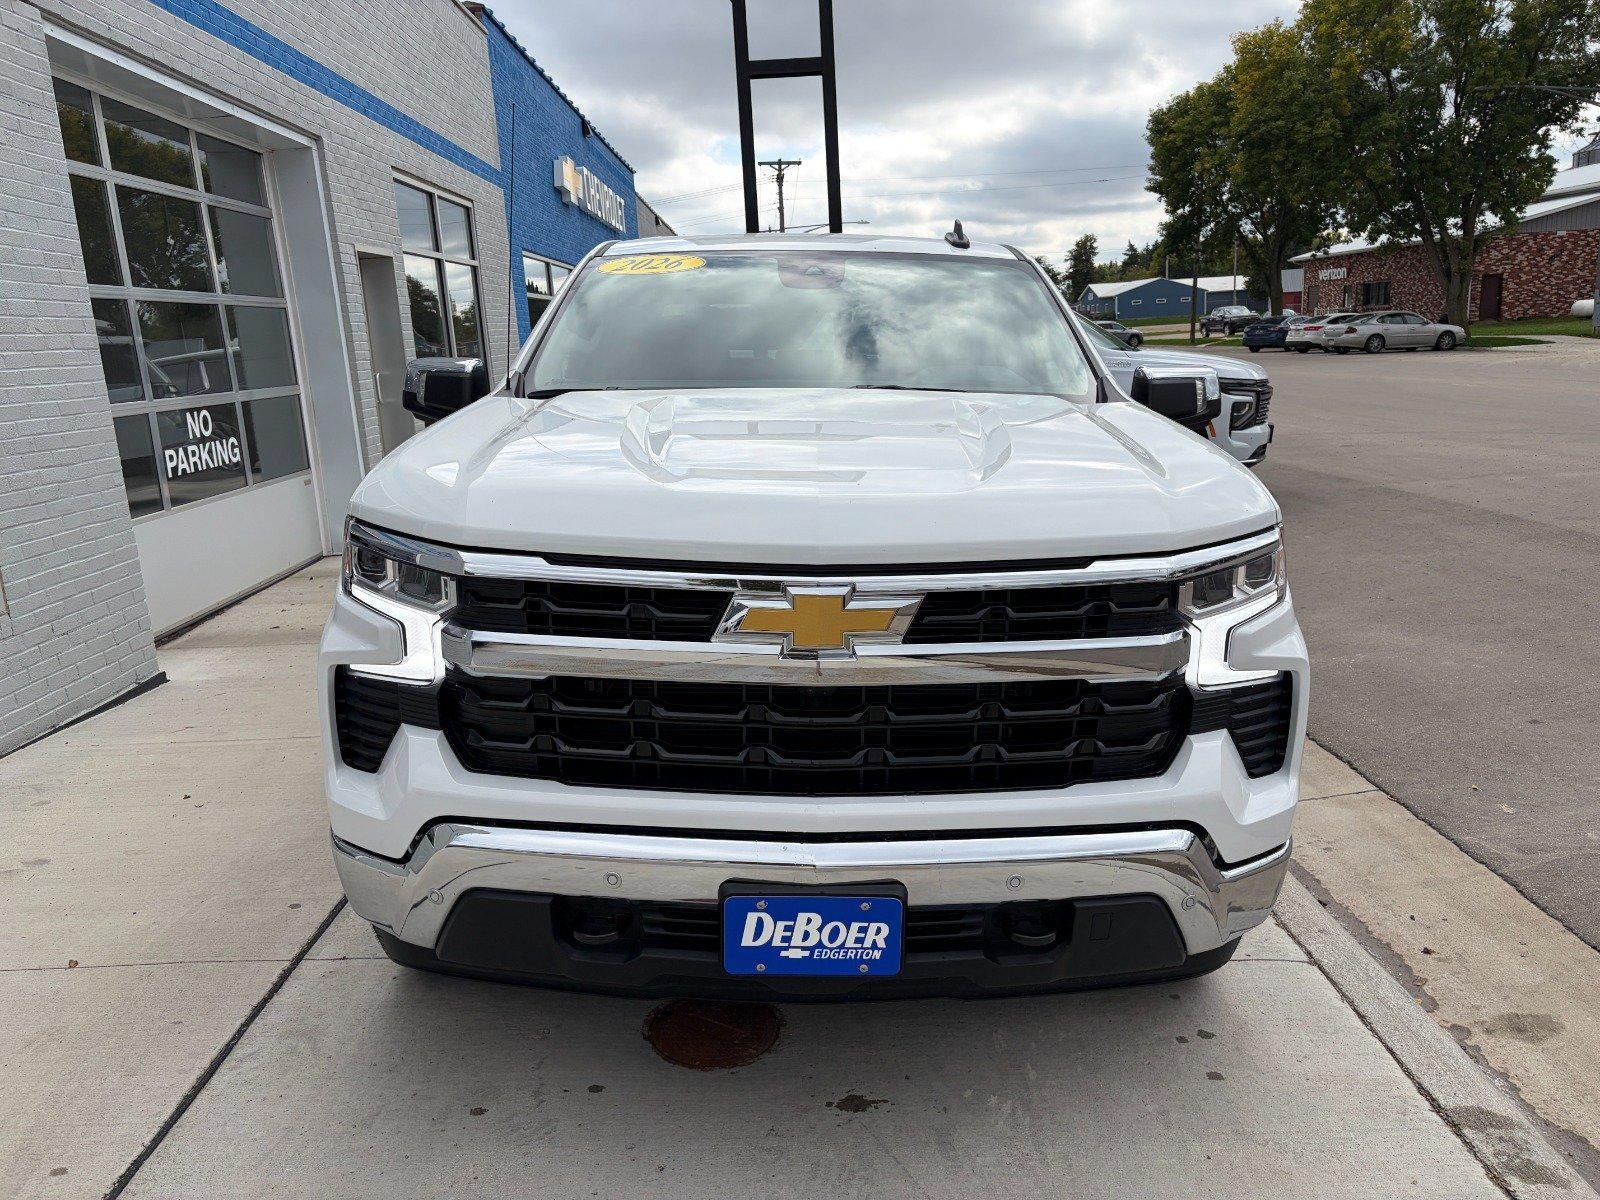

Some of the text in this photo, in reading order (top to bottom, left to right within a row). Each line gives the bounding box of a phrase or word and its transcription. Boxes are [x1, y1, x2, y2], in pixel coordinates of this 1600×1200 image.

[582, 166, 626, 234] CHEVROLET
[611, 257, 684, 271] 2026
[1318, 265, 1347, 281] verizon
[186, 409, 213, 439] NO
[164, 437, 241, 478] PARKING
[813, 948, 882, 960] EDGERTON
